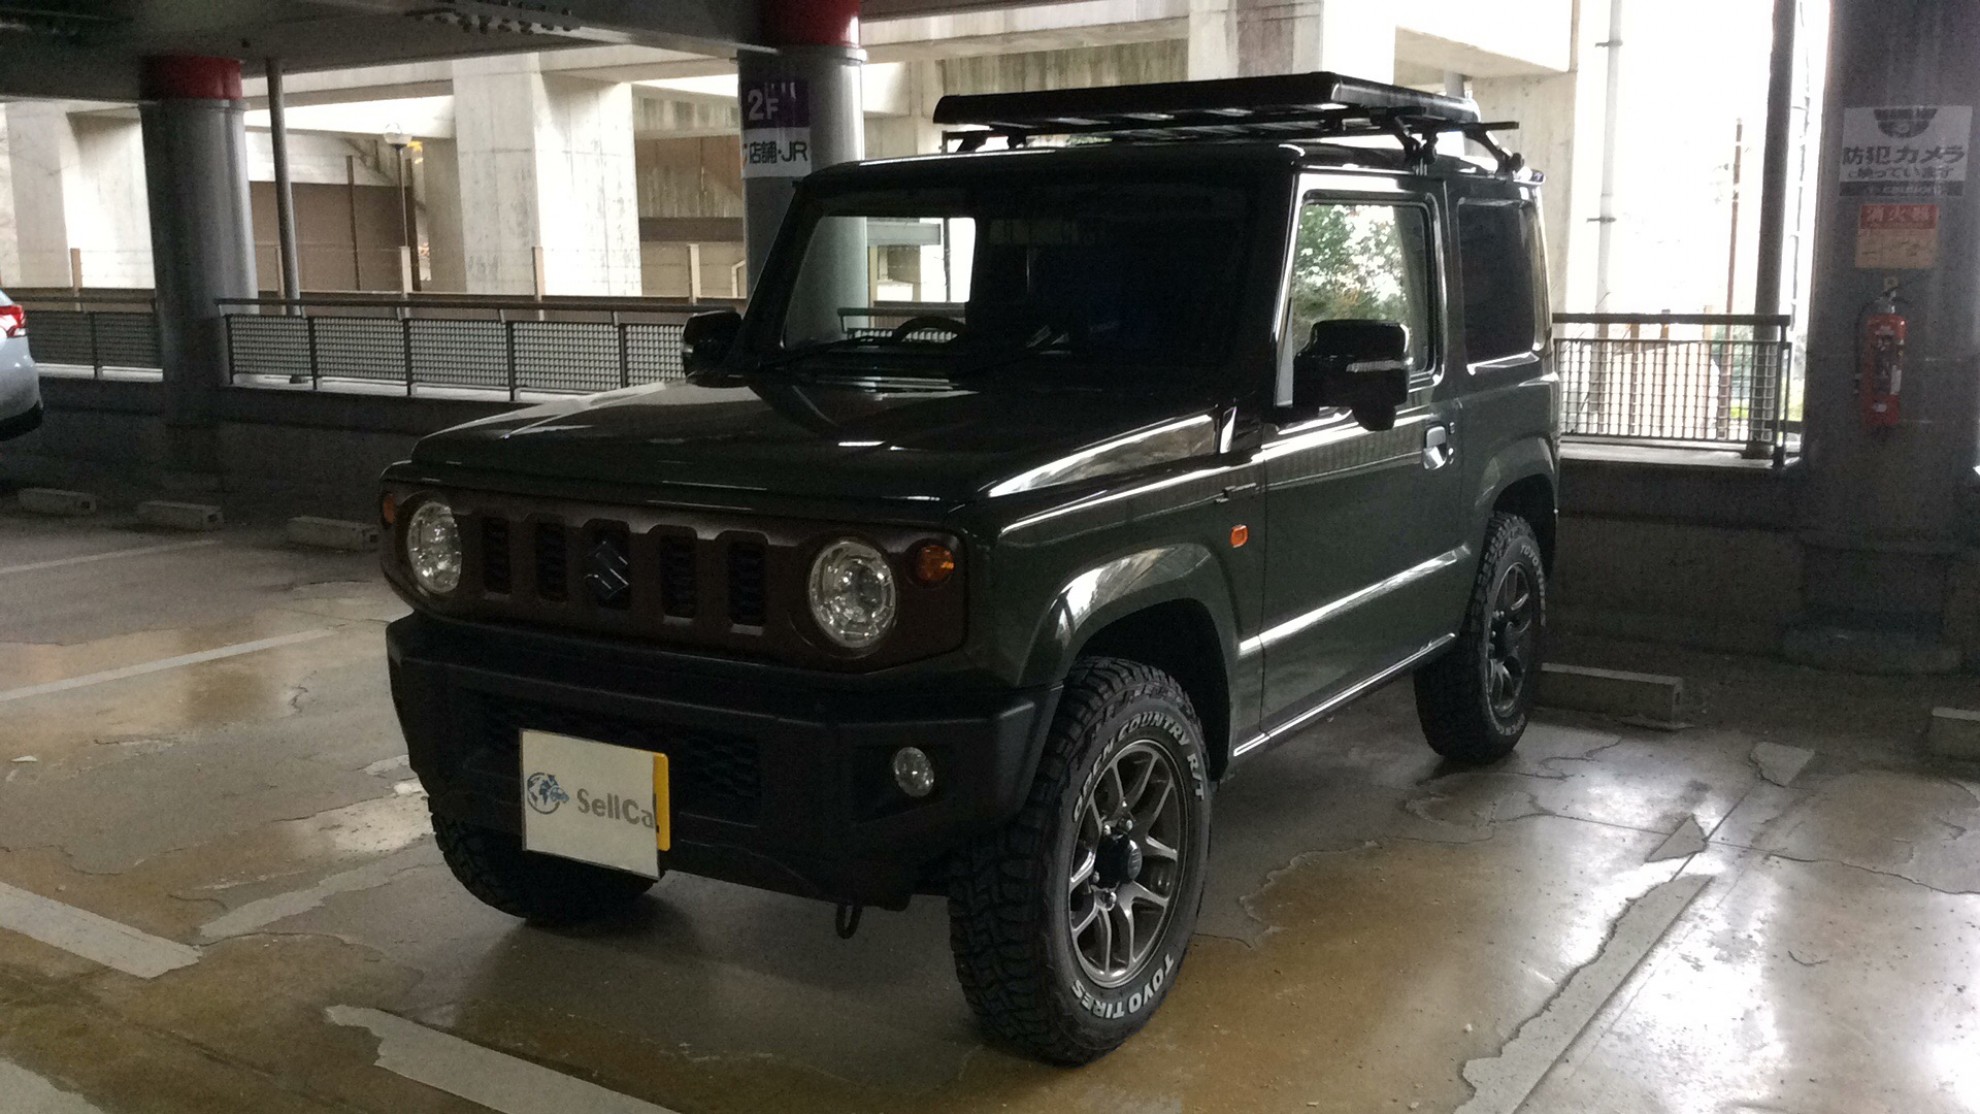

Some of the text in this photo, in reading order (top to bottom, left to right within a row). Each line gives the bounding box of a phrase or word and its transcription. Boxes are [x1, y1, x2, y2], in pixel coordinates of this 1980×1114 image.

[747, 89, 779, 120] 2F
[1843, 145, 1965, 165] 防犯カメラ
[1117, 711, 1190, 746] COUNTRY
[1187, 753, 1206, 800] R/T
[576, 788, 655, 829] SellCa
[1071, 953, 1175, 1019] TOYO TIRES
